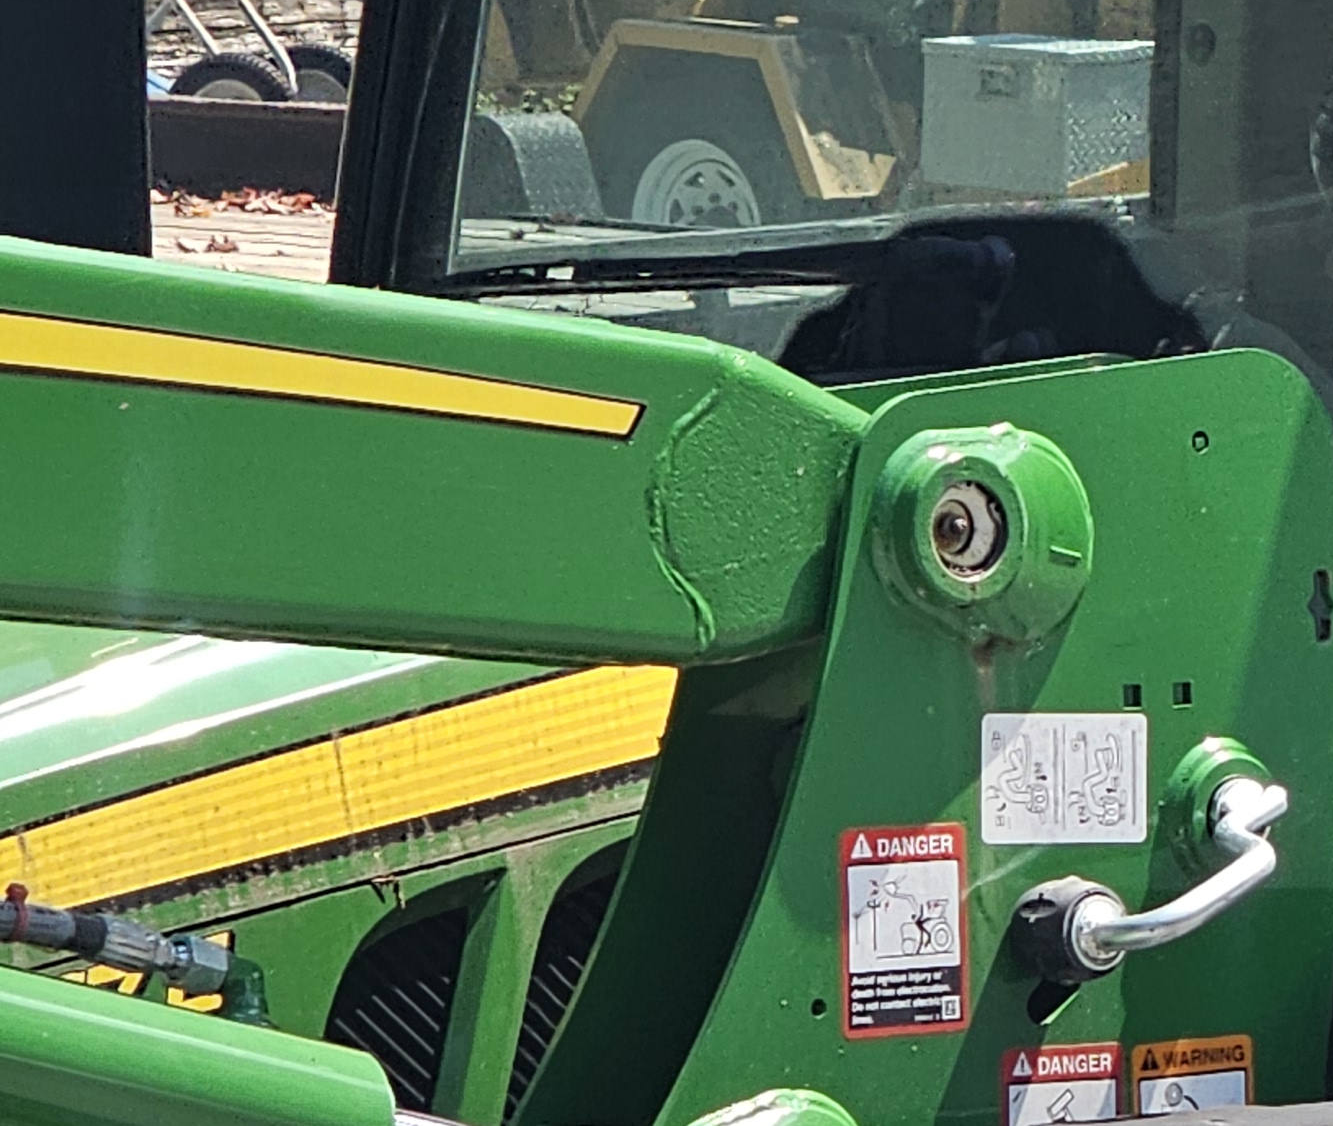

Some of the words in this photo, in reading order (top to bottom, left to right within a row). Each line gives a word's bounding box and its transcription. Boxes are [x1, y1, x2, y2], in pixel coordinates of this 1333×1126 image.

[876, 835, 954, 858] DANGER
[1037, 1052, 1113, 1075] DANGER
[1163, 1044, 1245, 1068] WARNING
